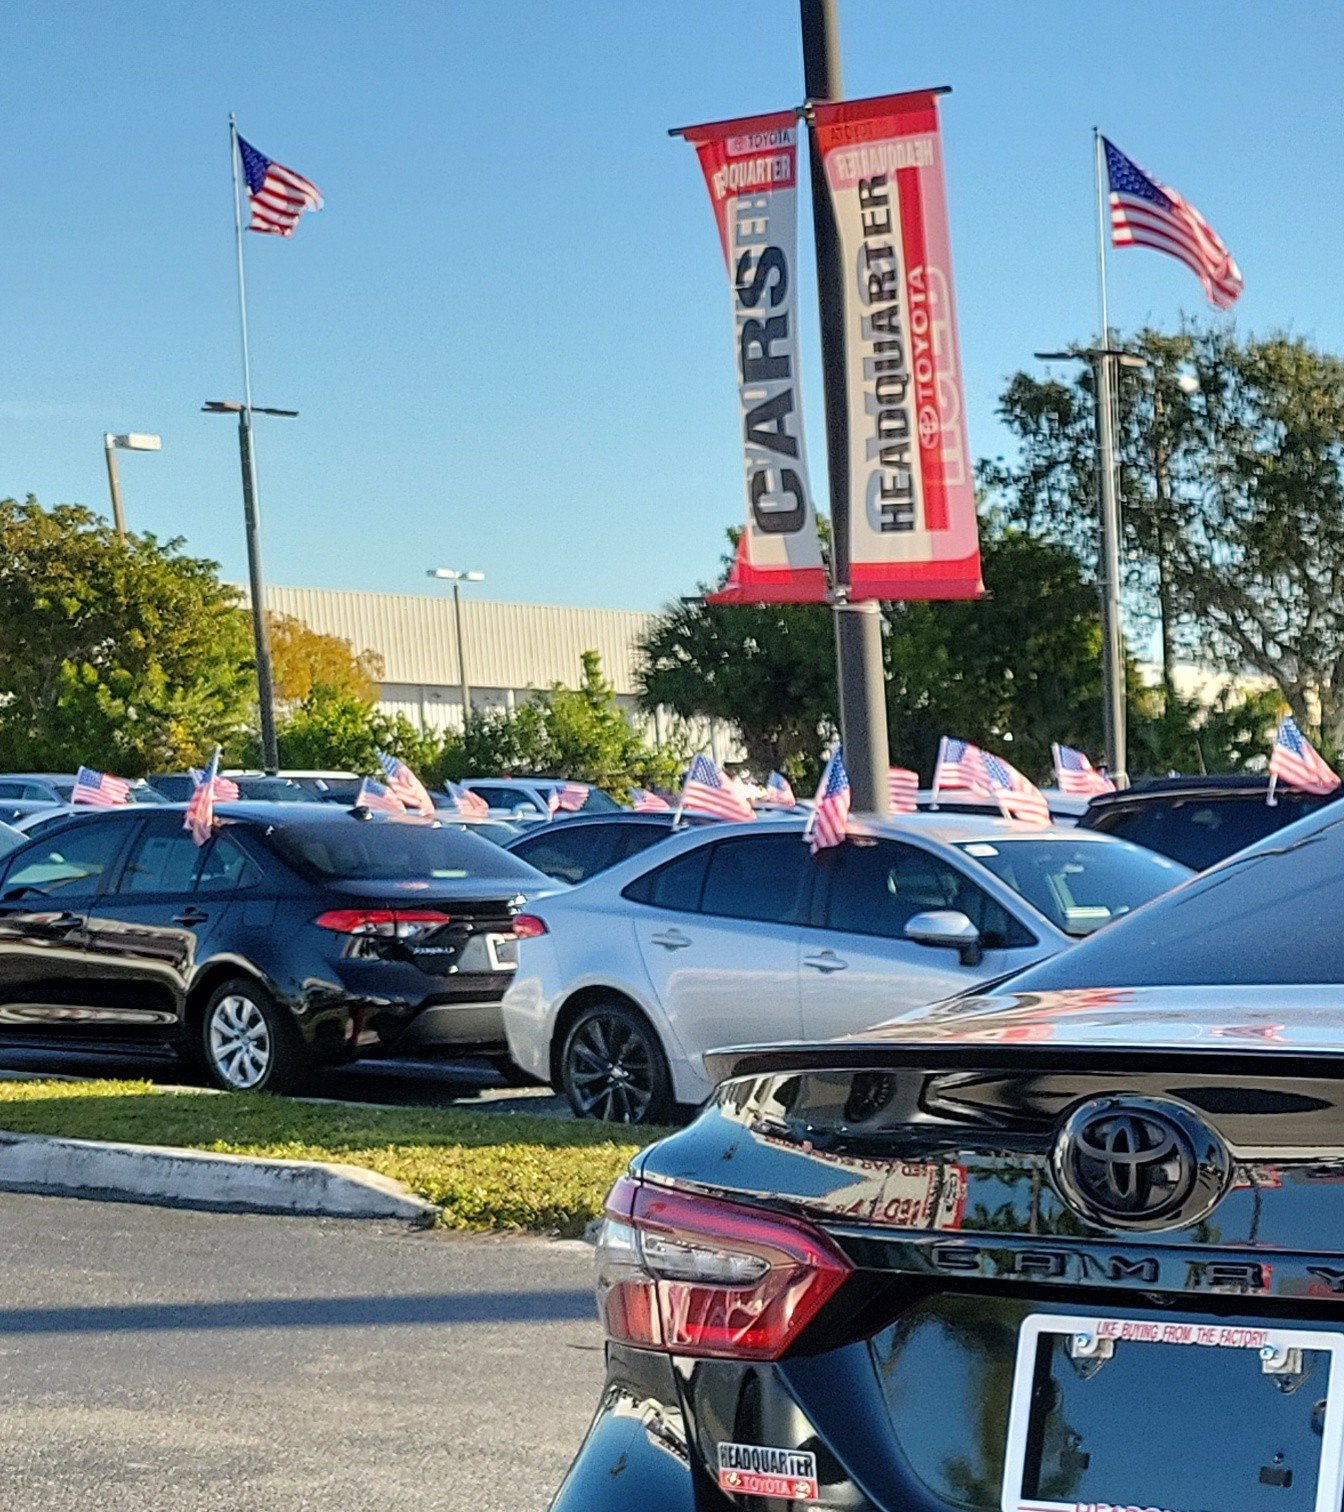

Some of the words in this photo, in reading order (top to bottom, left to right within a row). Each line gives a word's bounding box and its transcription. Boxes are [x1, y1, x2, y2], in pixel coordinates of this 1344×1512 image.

[749, 131, 791, 148] TOYOTA
[713, 153, 791, 199] QUARTER
[858, 173, 916, 533] HEADQUARTER
[908, 264, 936, 402] TOYOTA
[736, 246, 808, 534] CARS
[1096, 1321, 1118, 1337] LIKE
[1121, 1323, 1158, 1341] BUYING
[1163, 1325, 1191, 1343] FROM
[1197, 1327, 1216, 1344] THE
[720, 1444, 814, 1478] HEADQUARTER
[743, 1476, 792, 1495] TOYOTA
